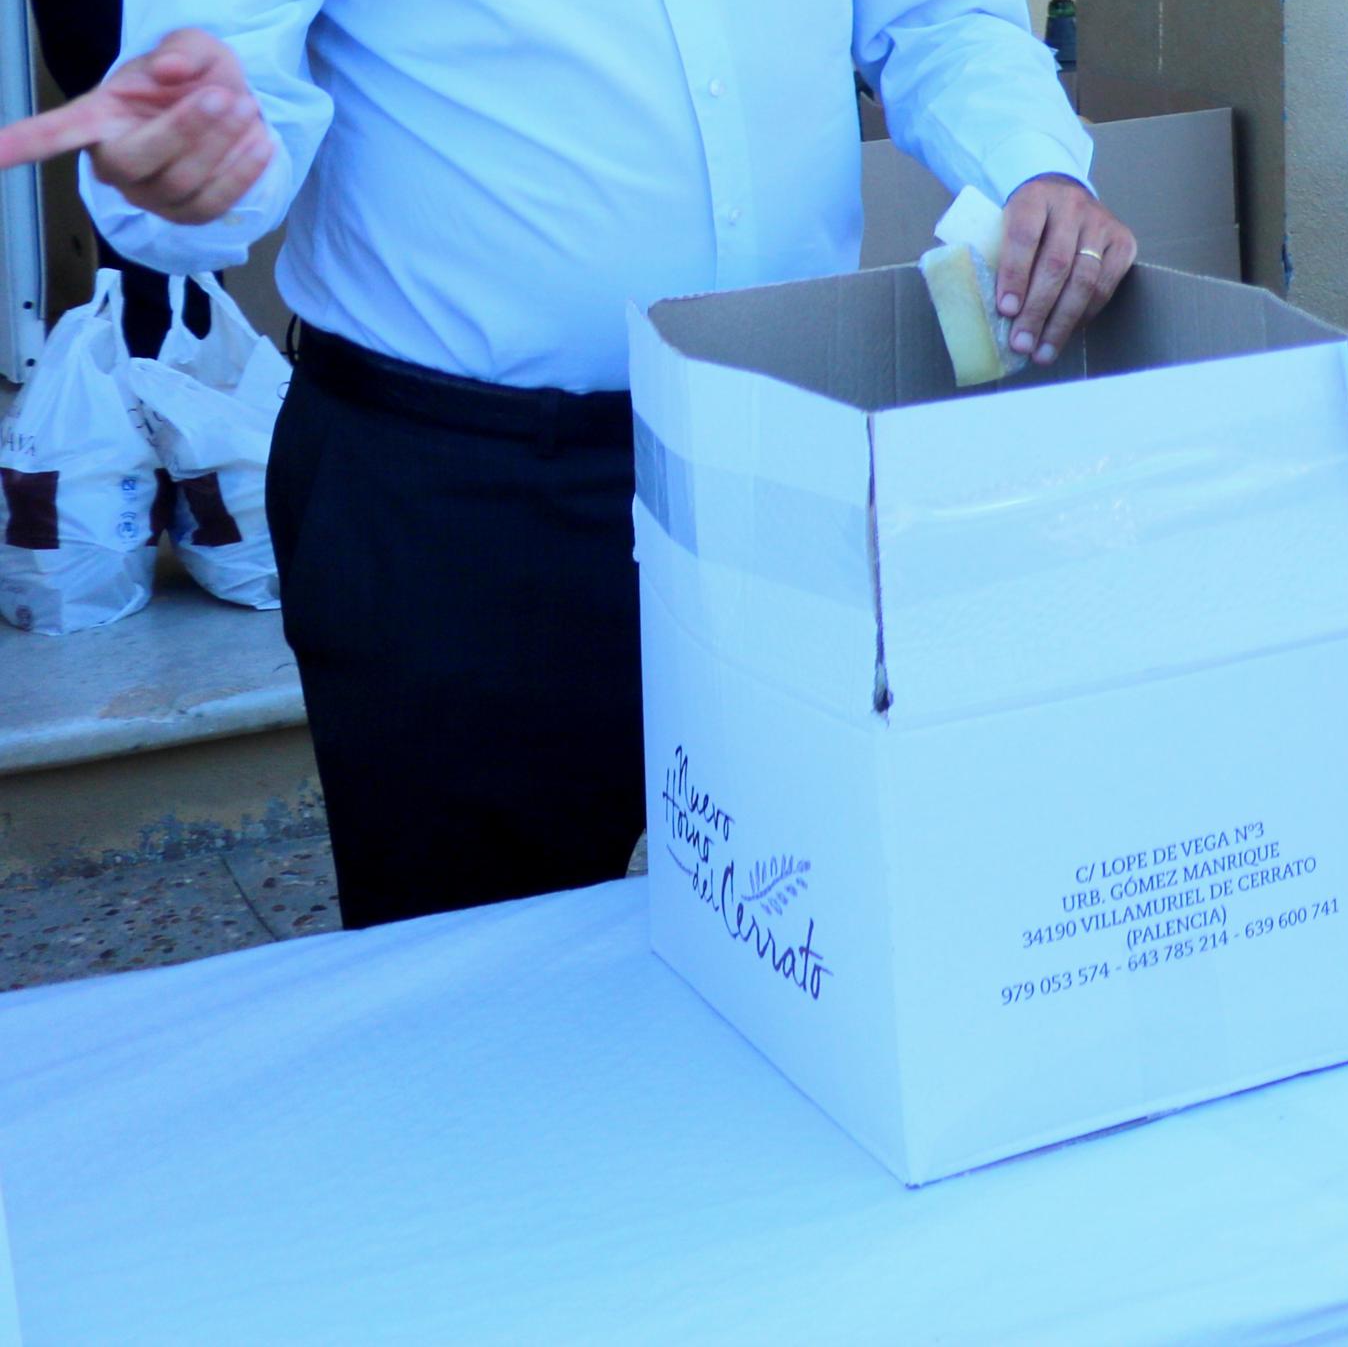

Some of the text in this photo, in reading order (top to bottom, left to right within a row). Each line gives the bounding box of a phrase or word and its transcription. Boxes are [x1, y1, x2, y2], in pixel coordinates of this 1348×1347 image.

[662, 768, 715, 863] Horno
[675, 745, 735, 842] Nuevo
[1022, 856, 1318, 949] 34190 VILLAMURIEL DE CERRATO
[1061, 843, 1281, 913] URB. GÓMEZ MANRIQUE
[1075, 863, 1096, 884] C/
[1101, 853, 1148, 879] LOPE
[1153, 845, 1178, 866] DE
[1180, 831, 1230, 857] VEGA
[692, 861, 834, 1000] del Cerrato
[1000, 981, 1036, 1006] 979
[1039, 971, 1074, 995] 053
[1077, 961, 1112, 986] 574
[1127, 950, 1160, 973] 643
[1164, 939, 1194, 963] 785
[1198, 929, 1230, 953] 214
[1244, 916, 1275, 940] 639
[1277, 908, 1309, 929] 600
[1311, 897, 1341, 921] 741
[1126, 905, 1228, 952] (PALENCIA)
